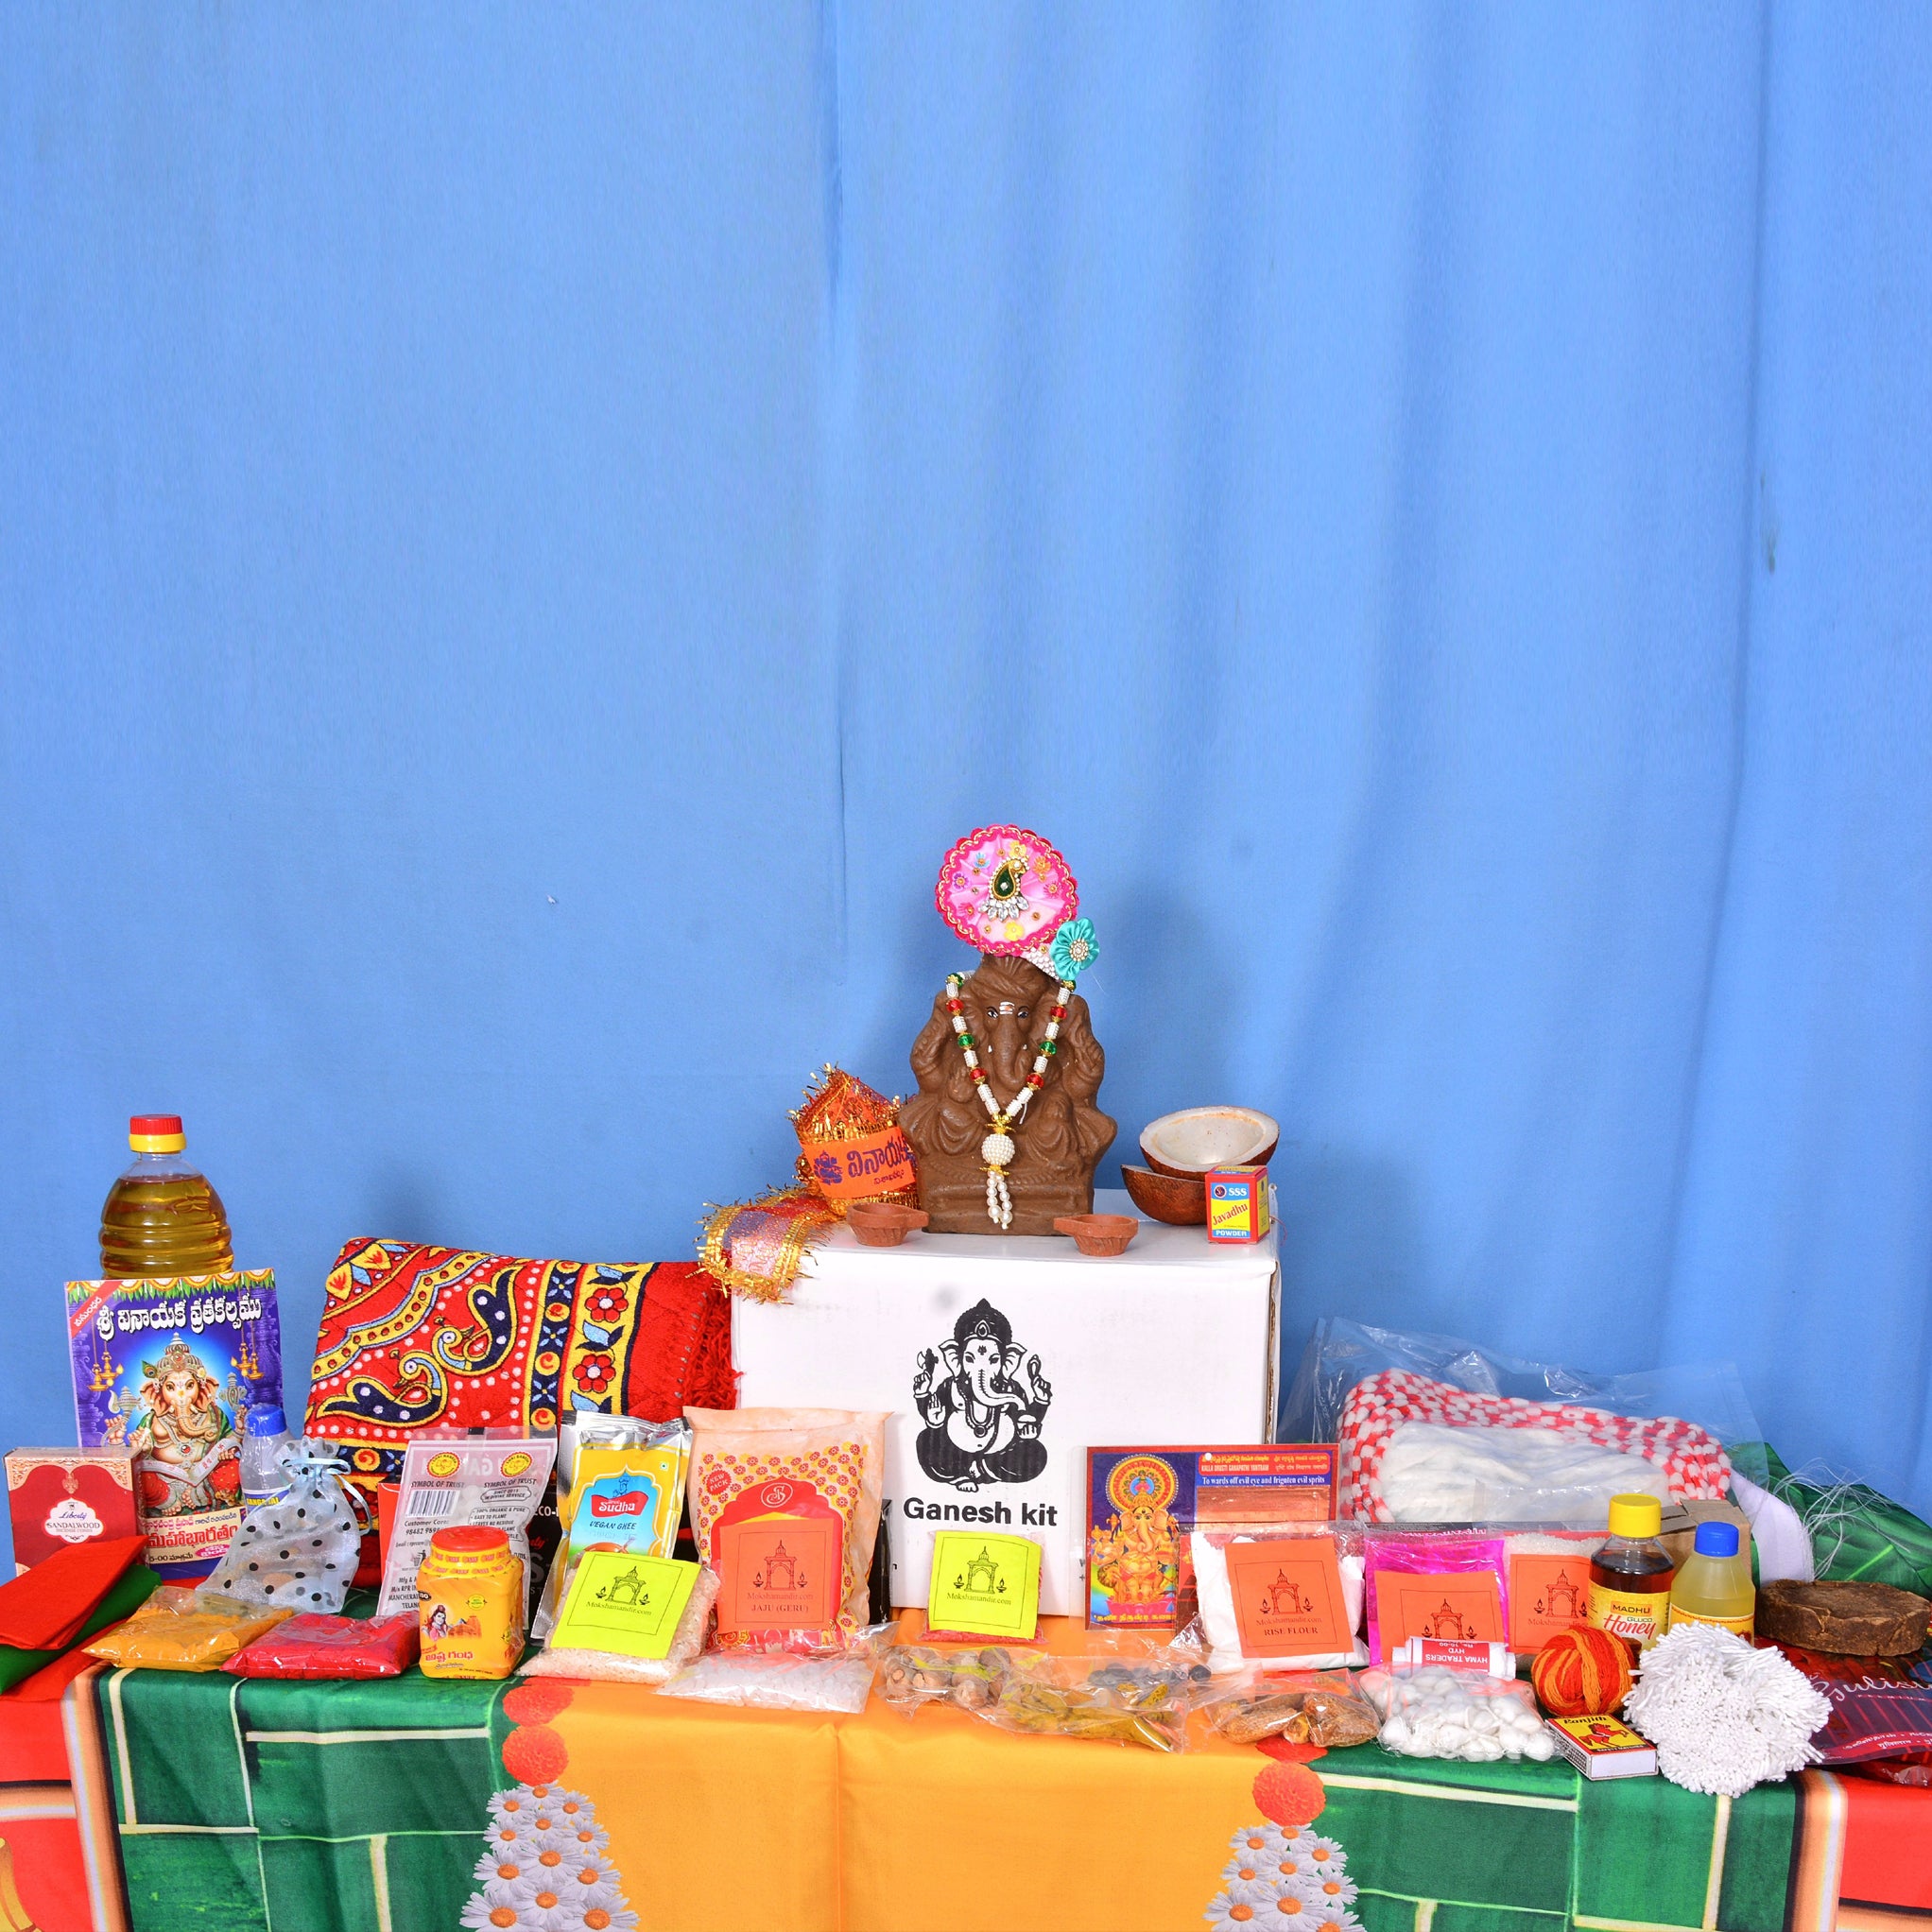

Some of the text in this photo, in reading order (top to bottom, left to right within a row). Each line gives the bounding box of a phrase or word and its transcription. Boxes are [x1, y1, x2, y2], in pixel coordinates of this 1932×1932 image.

[1229, 1187, 1247, 1196] SSS
[1212, 1204, 1248, 1226] Javadhu
[96, 1305, 114, 1341] శ్రీ
[117, 1300, 187, 1334] వినాయక
[709, 1474, 725, 1485] NEW
[709, 1479, 728, 1492] PACK
[598, 1501, 636, 1512] Sudha
[904, 1497, 1058, 1527] Ganesh kit
[59, 1511, 87, 1520] Liberty
[590, 1521, 637, 1530] VEGAN GHEE
[748, 1587, 813, 1600] Mokshamandir.com
[946, 1592, 1011, 1606] Mokshamandir.com
[586, 1600, 652, 1616] Mokshamandir.com
[776, 1604, 808, 1613] (GERU)
[1612, 1604, 1650, 1614] MADHU
[1256, 1616, 1322, 1627] Mokshamandir.com
[1604, 1613, 1656, 1640] Honey
[1264, 1626, 1319, 1636] RISE FLOUR
[1425, 1654, 1488, 1664] HYMA TRADERS
[1564, 1716, 1607, 1724] Ranjith
